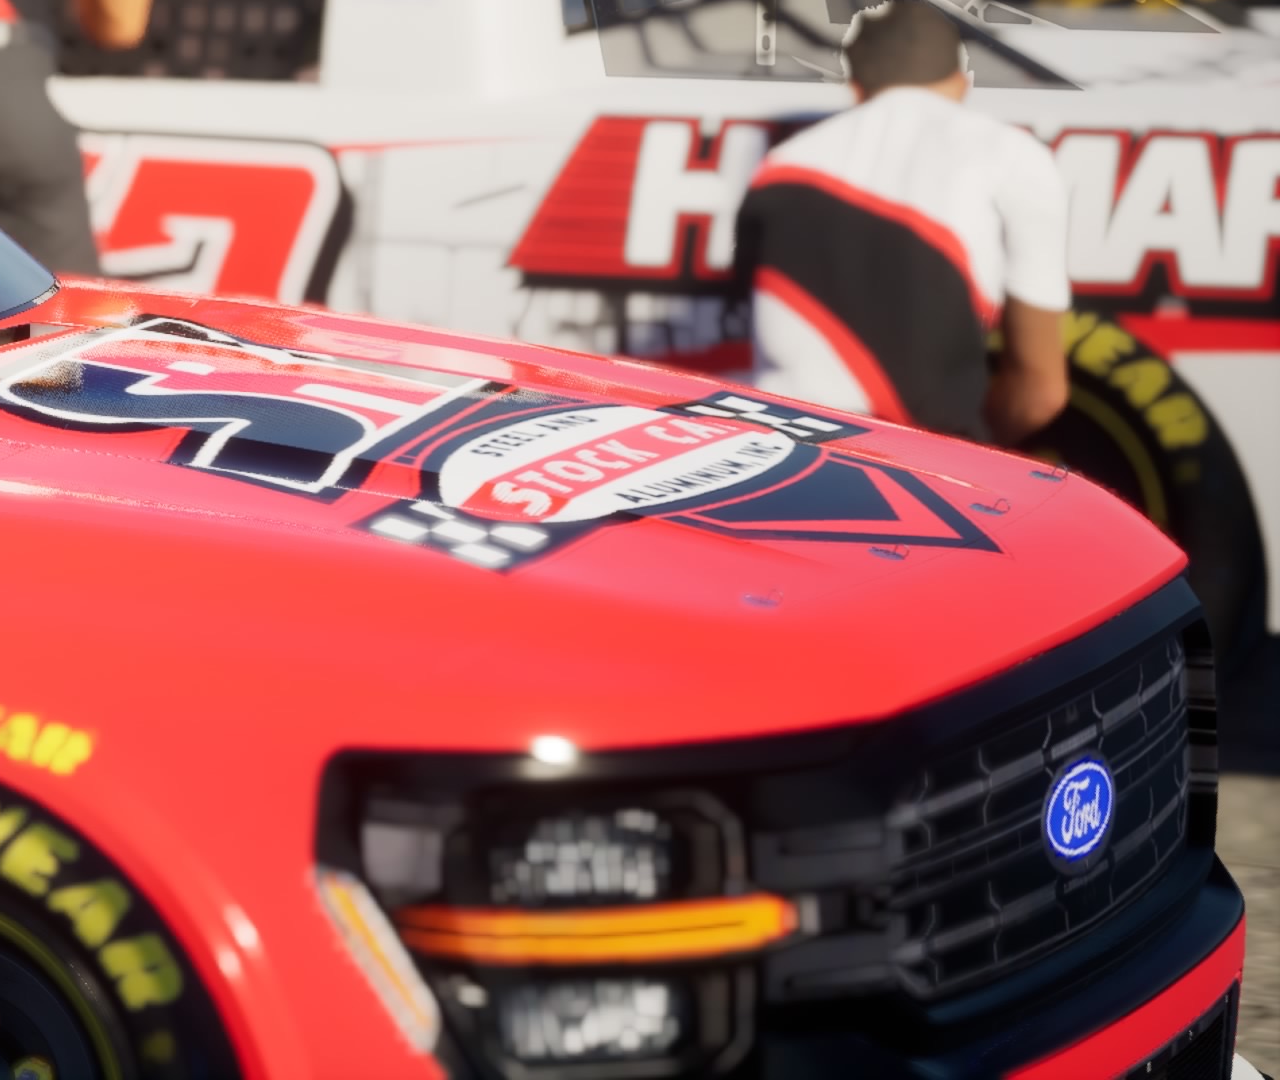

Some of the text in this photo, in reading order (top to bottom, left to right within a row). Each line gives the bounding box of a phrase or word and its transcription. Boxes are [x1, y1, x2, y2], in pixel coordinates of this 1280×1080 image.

[470, 414, 599, 458] STEEL AND
[491, 438, 661, 517] STOCK
[1061, 775, 1101, 845] Ford
